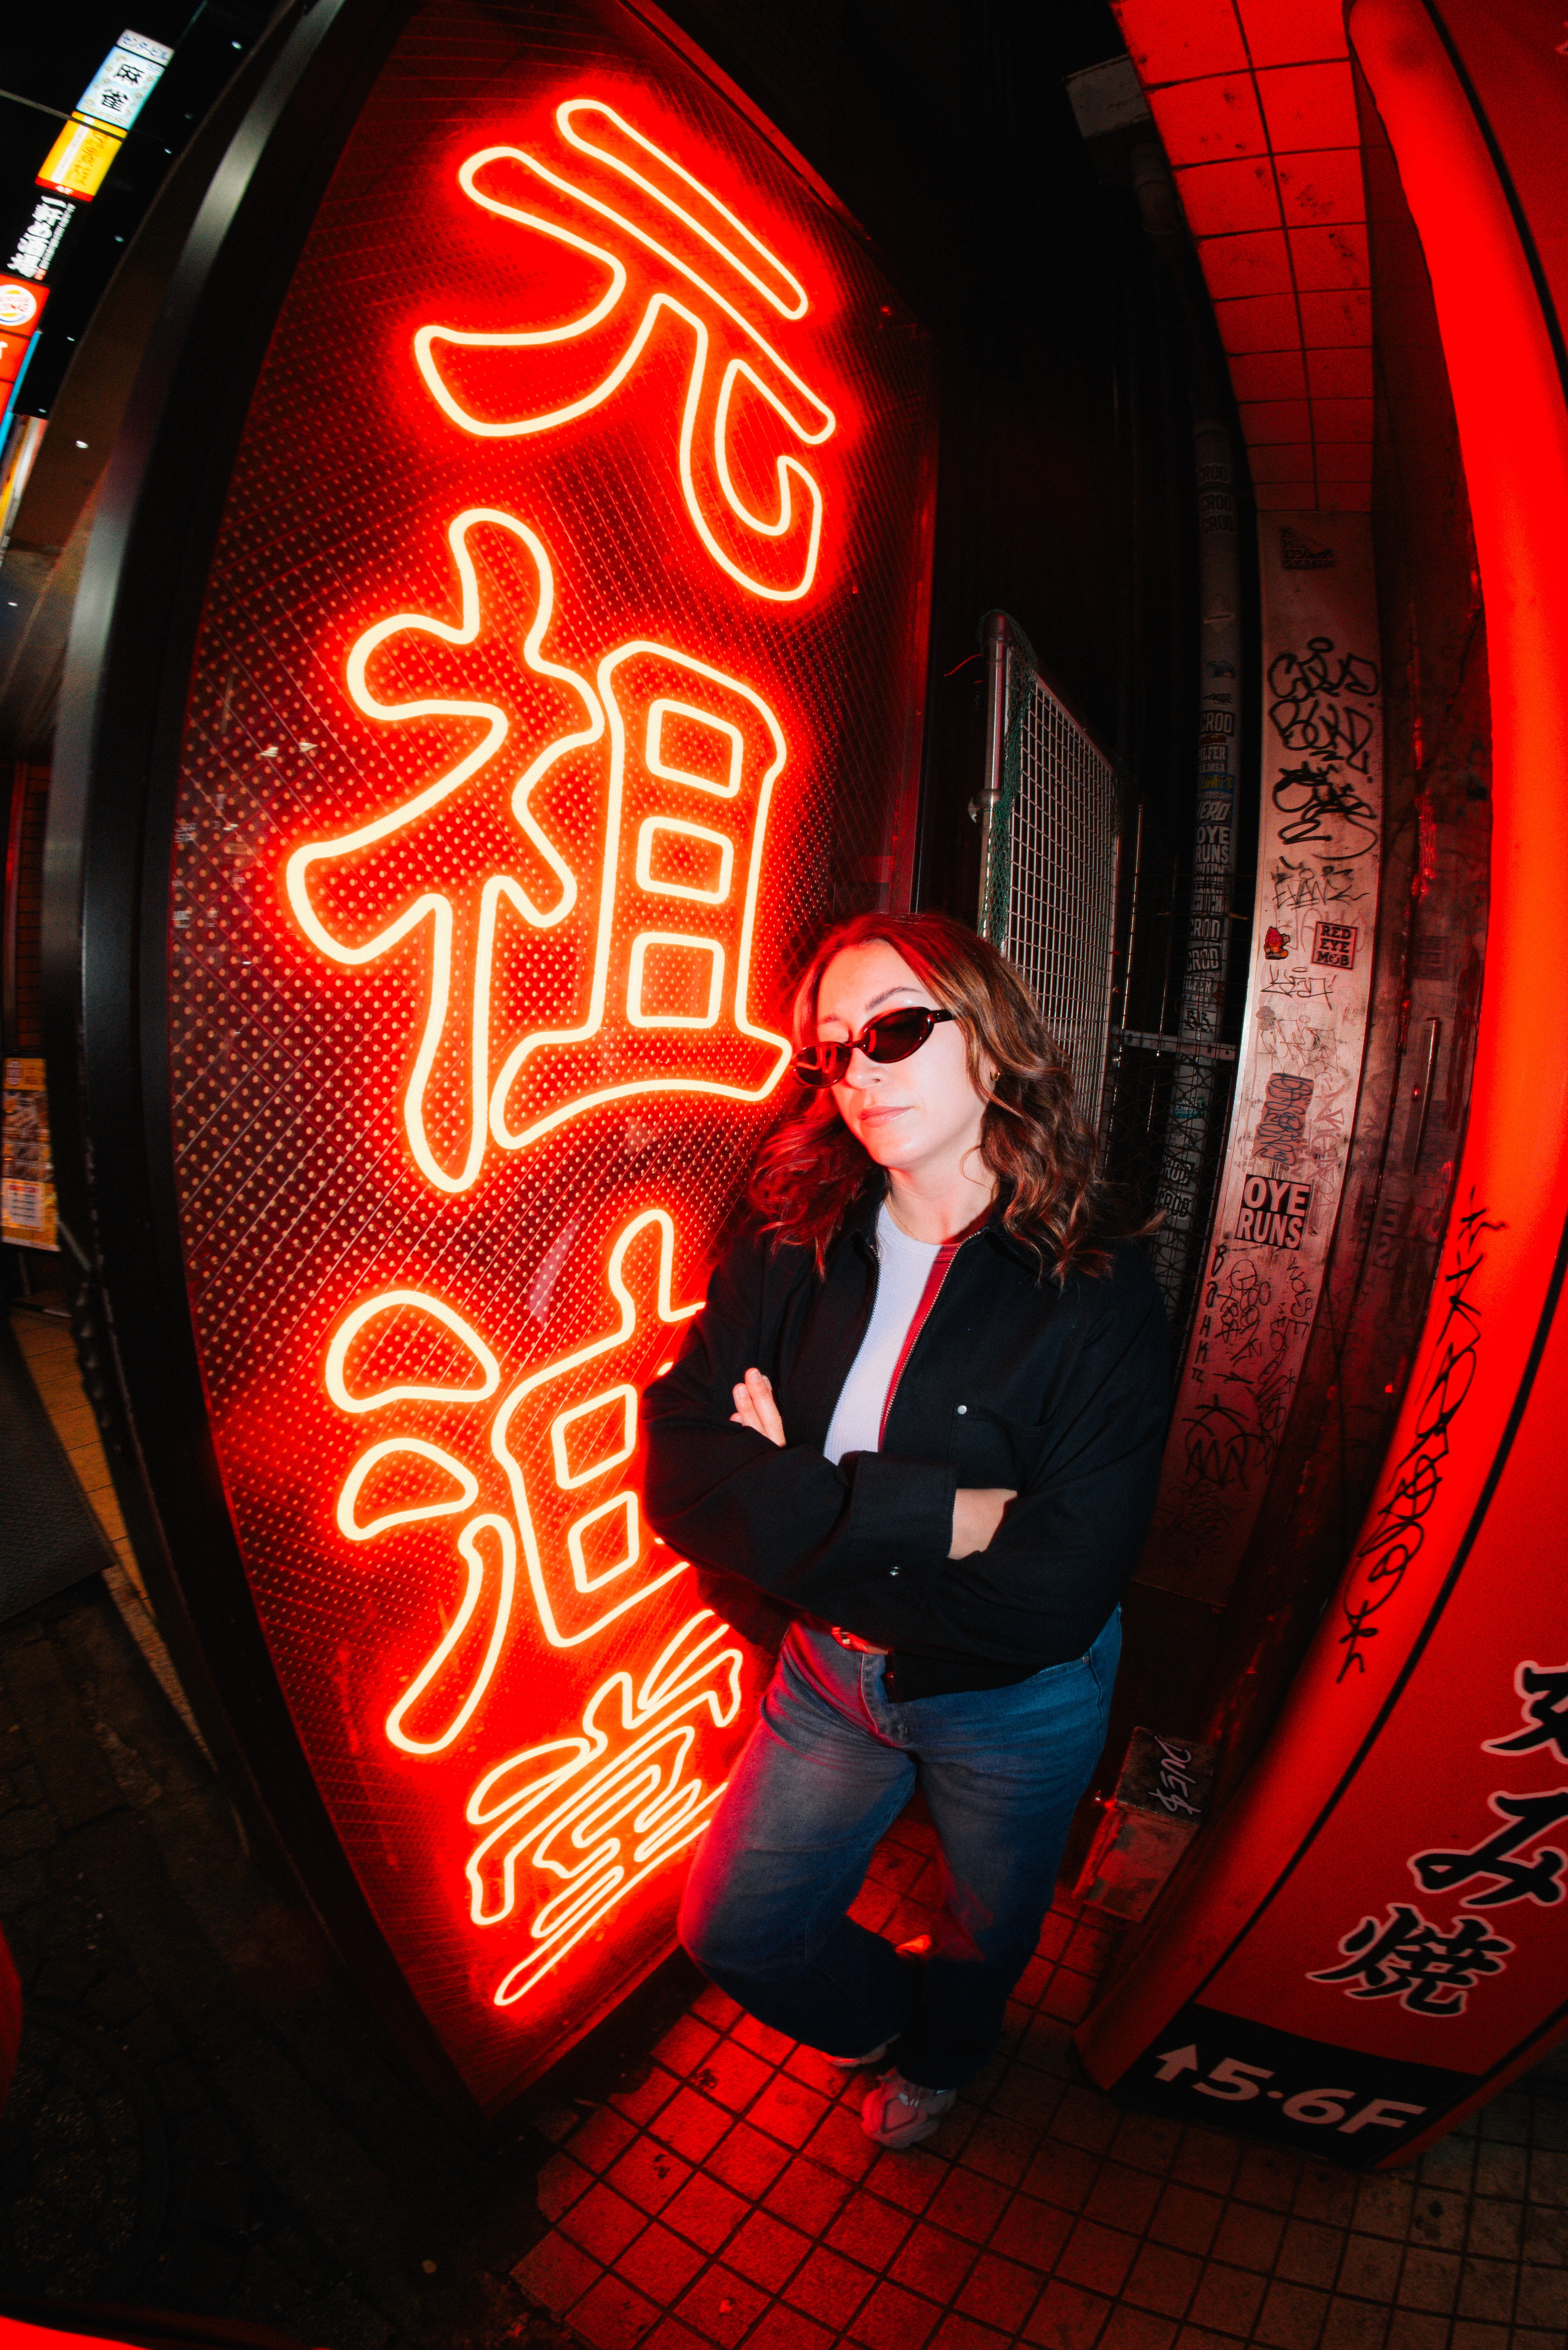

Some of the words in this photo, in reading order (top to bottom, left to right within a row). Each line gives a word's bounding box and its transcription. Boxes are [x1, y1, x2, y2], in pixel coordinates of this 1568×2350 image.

[101, 63, 145, 112] 麻雀
[1196, 825, 1230, 845] OYE
[1196, 844, 1229, 864] RUNS
[1320, 924, 1352, 939] RED
[1319, 938, 1350, 953] EYE
[1317, 950, 1349, 967] MOB
[1243, 1176, 1312, 1217] OYE
[1237, 1208, 1305, 1249] RUNS
